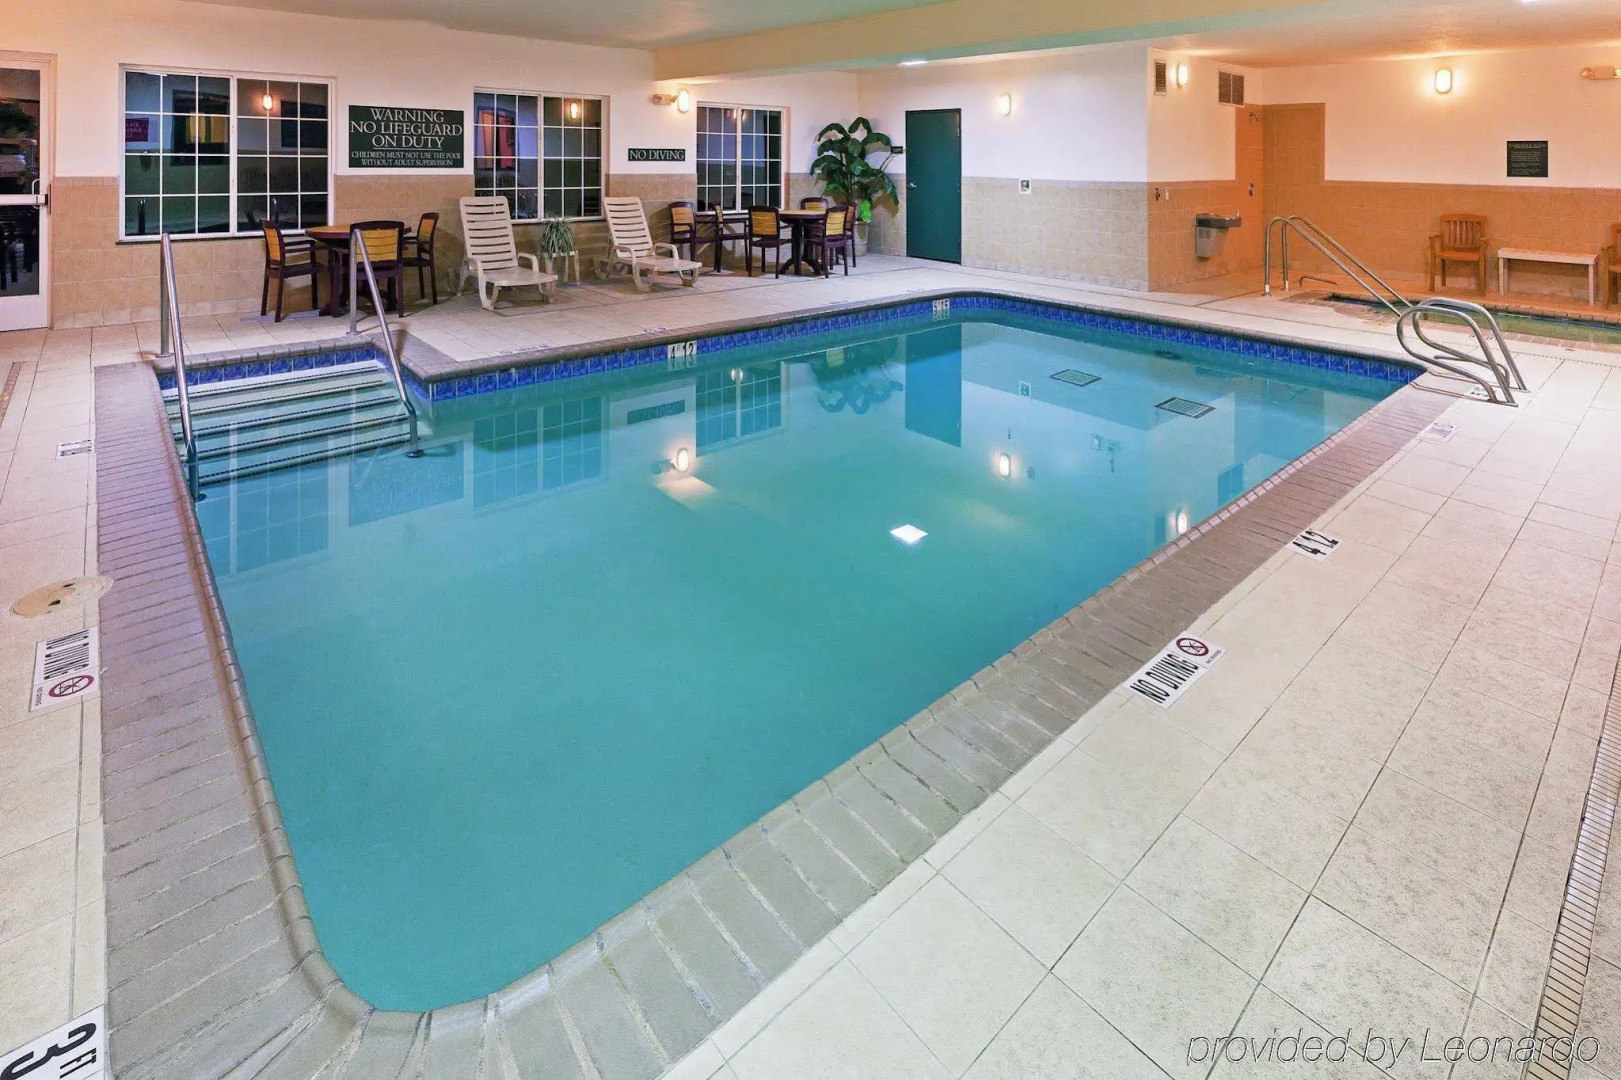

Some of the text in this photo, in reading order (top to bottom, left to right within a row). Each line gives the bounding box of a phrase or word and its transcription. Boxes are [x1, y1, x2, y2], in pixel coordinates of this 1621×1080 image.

[370, 108, 445, 123] WARNING
[350, 121, 463, 136] NO LIFEGUARD
[372, 135, 445, 148] ON DUTY
[630, 150, 684, 160] NO DIVING
[43, 642, 90, 681] DIVING
[1129, 653, 1200, 704] NO DIVING
[59, 1047, 97, 1079] FT
